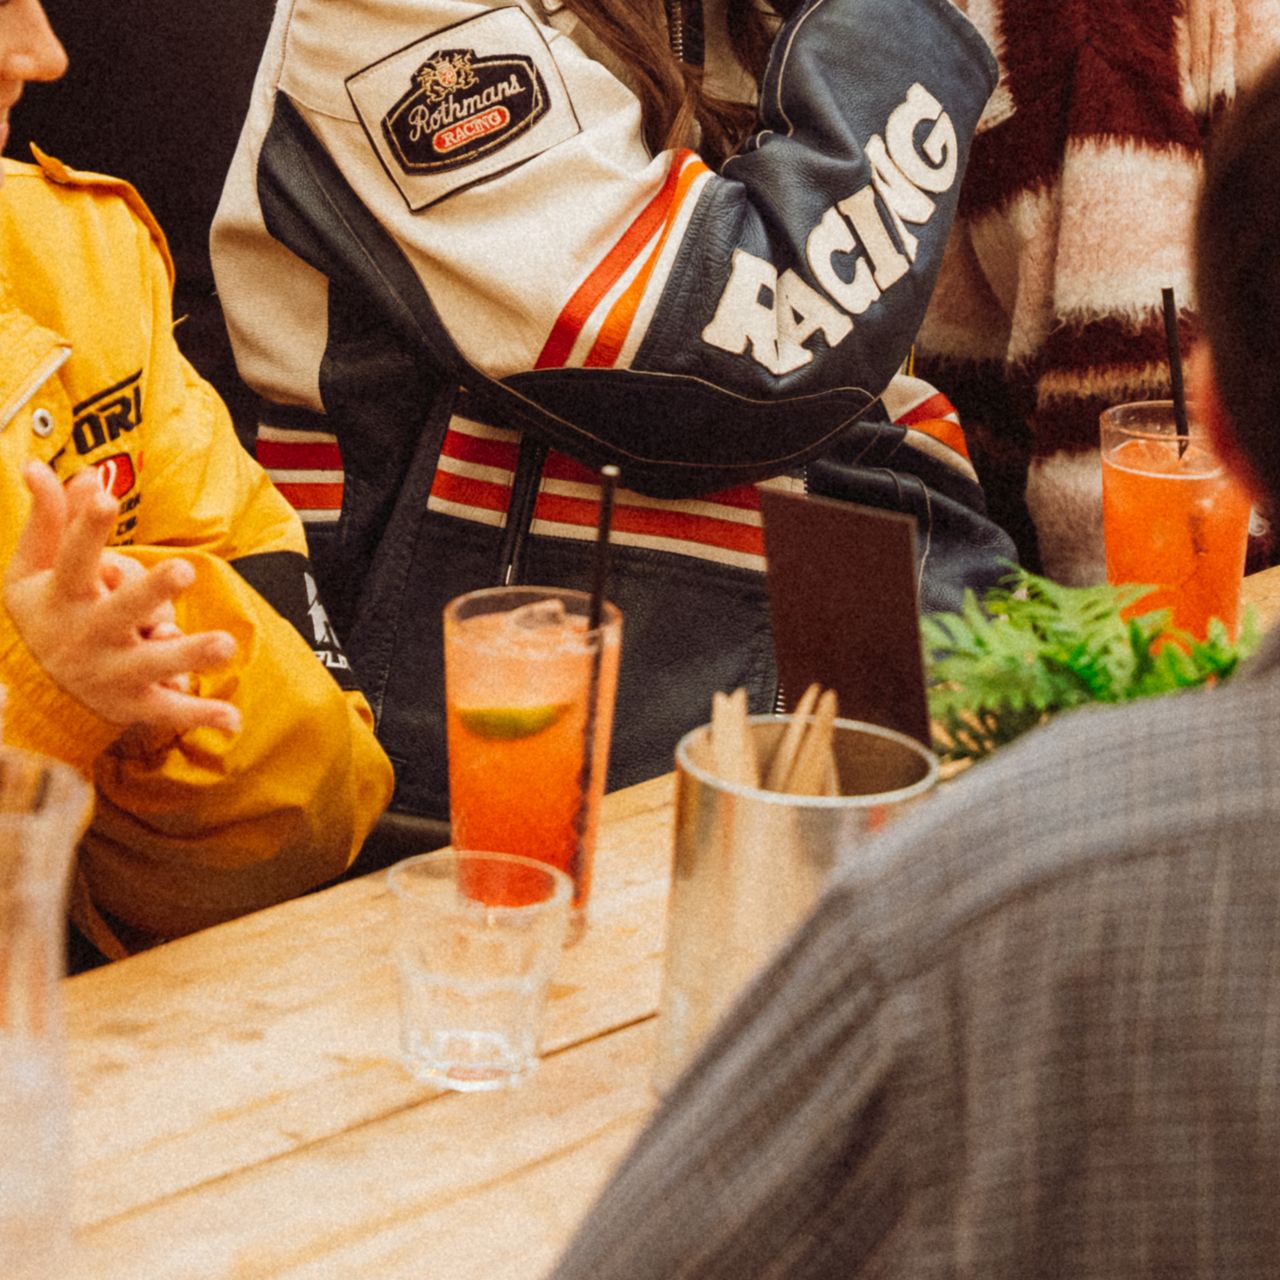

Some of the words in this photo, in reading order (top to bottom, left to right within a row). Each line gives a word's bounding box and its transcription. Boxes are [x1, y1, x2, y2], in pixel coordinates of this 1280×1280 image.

[408, 73, 527, 144] Rothmans
[442, 112, 504, 146] RACING
[701, 81, 960, 375] RACING
